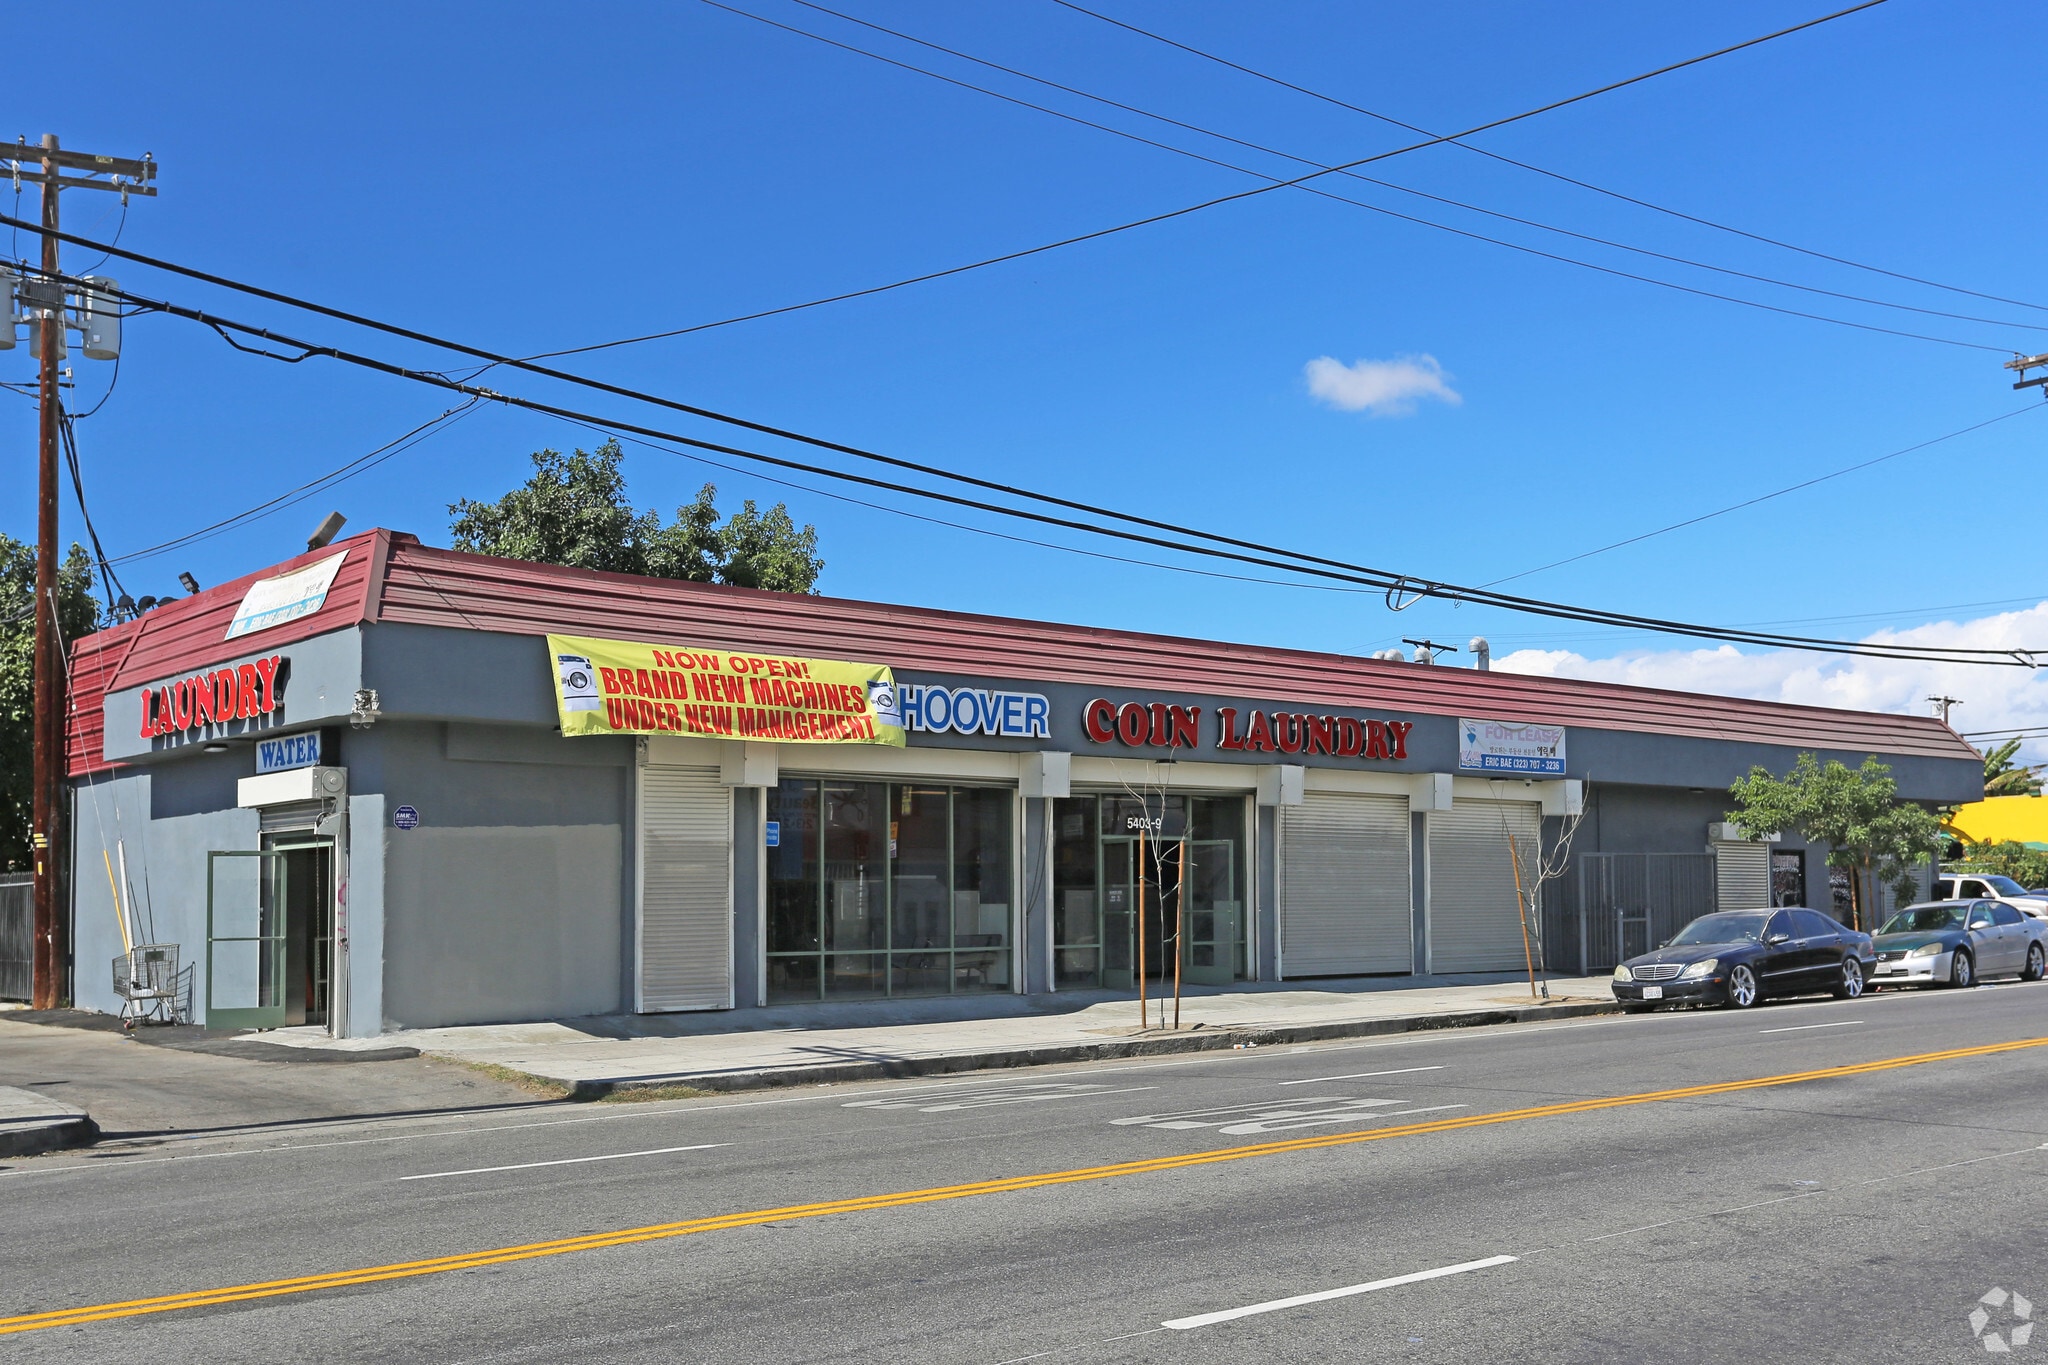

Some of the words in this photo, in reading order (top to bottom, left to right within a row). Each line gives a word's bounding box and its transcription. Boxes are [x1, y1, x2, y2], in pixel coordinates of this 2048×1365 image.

[652, 650, 720, 671] NOW
[728, 656, 811, 679] OPEN!
[139, 654, 281, 739] LAUNDRY
[599, 667, 688, 700] BRAND
[691, 672, 746, 704] NEW
[749, 677, 867, 714] MACHINES
[606, 697, 682, 732] UNDER
[684, 703, 733, 735] NEW
[737, 707, 875, 740] MANAGEMENT
[898, 685, 1049, 736] HOOVER
[1082, 698, 1201, 749] COIN
[1216, 707, 1413, 760] LAUNDRY
[260, 734, 318, 769] WATER
[1485, 725, 1513, 741] FOR
[1518, 727, 1560, 743] LEASE
[1485, 757, 1500, 767] ERIC
[1500, 758, 1512, 768] BAE
[1127, 818, 1161, 829] 5403-9
